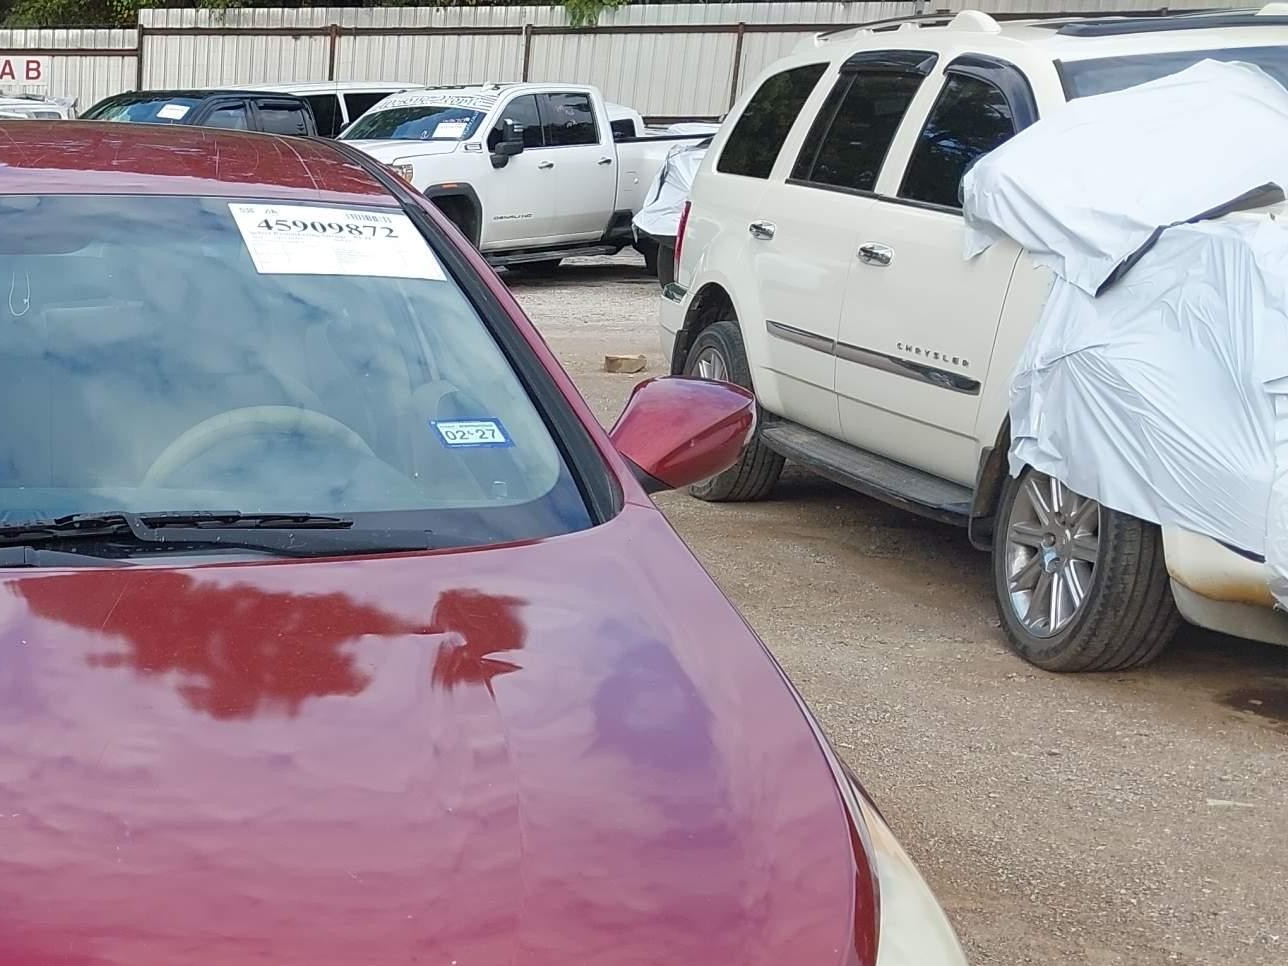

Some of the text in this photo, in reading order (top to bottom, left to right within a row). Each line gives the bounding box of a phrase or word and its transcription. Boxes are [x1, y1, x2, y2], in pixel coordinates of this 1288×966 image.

[0, 59, 42, 80] A B
[257, 218, 399, 239] 45909872
[897, 342, 970, 368] CHRYSLER
